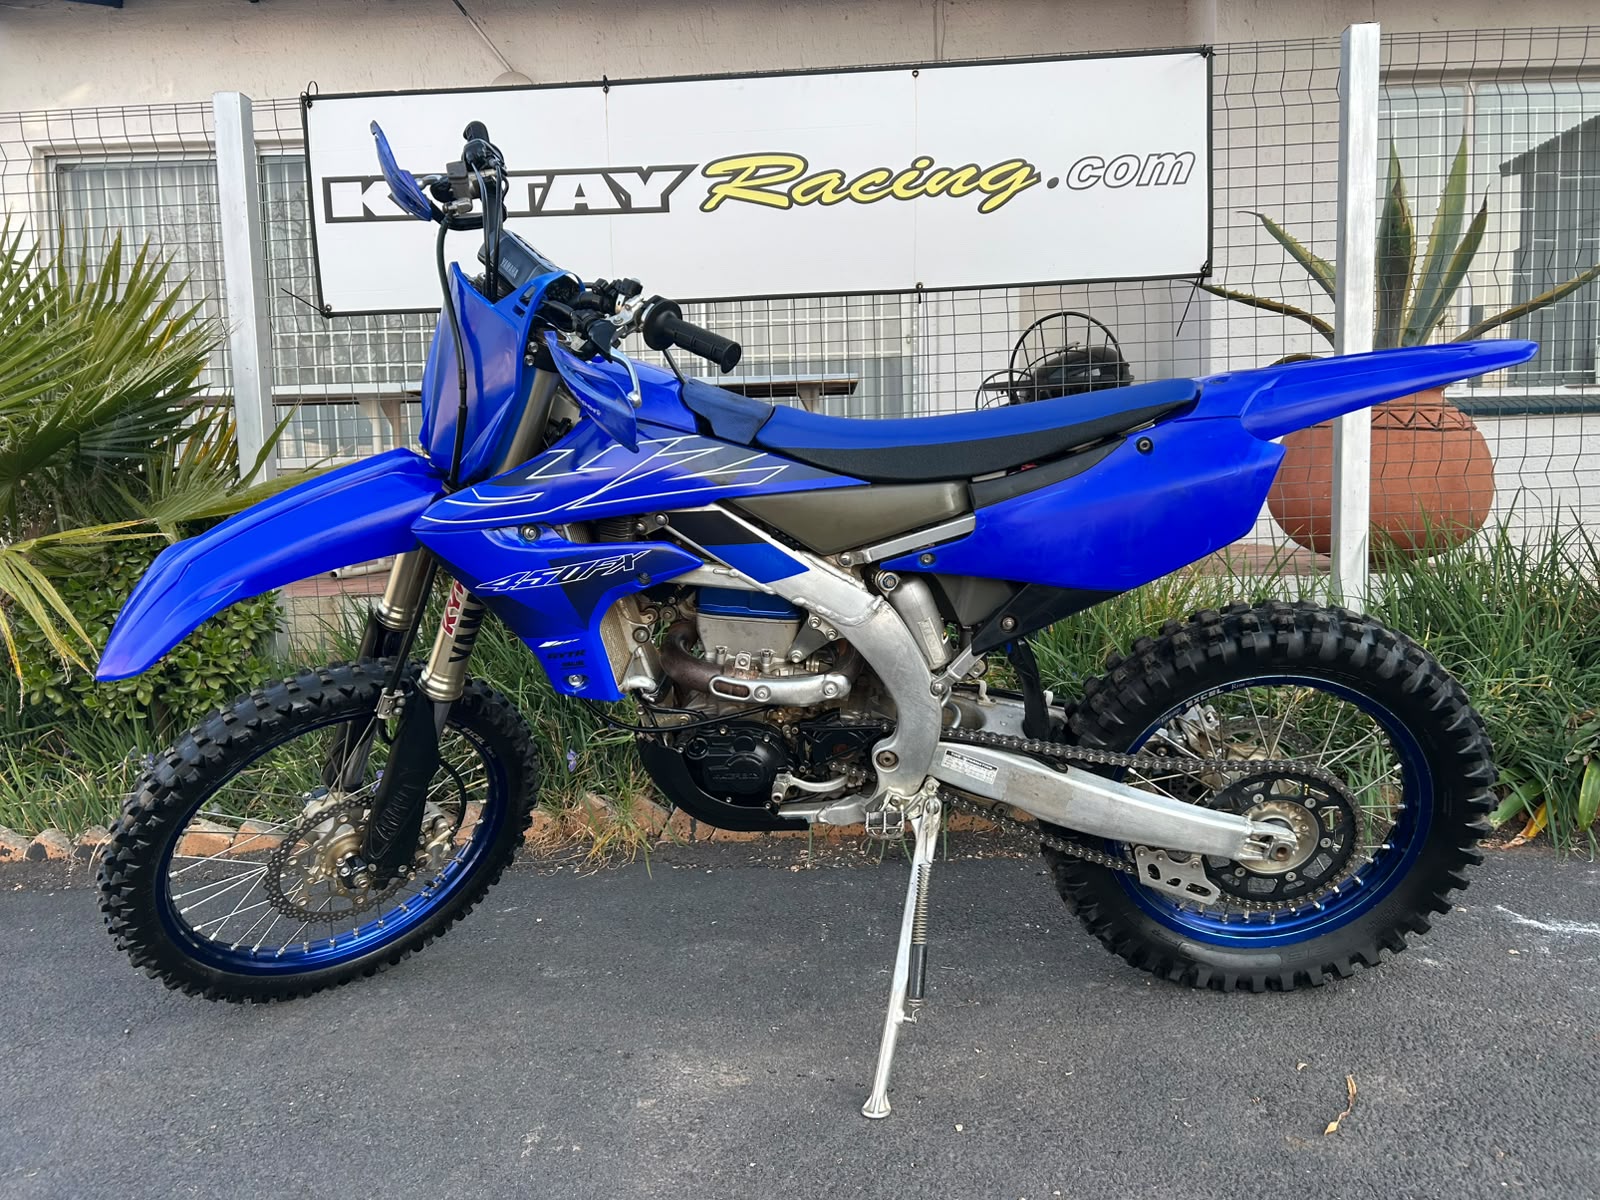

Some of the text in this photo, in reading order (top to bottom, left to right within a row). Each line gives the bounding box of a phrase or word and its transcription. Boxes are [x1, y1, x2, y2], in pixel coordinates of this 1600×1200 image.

[500, 257, 519, 279] YAMAHA
[475, 549, 652, 592] 450FX
[1185, 688, 1225, 708] EXCEL
